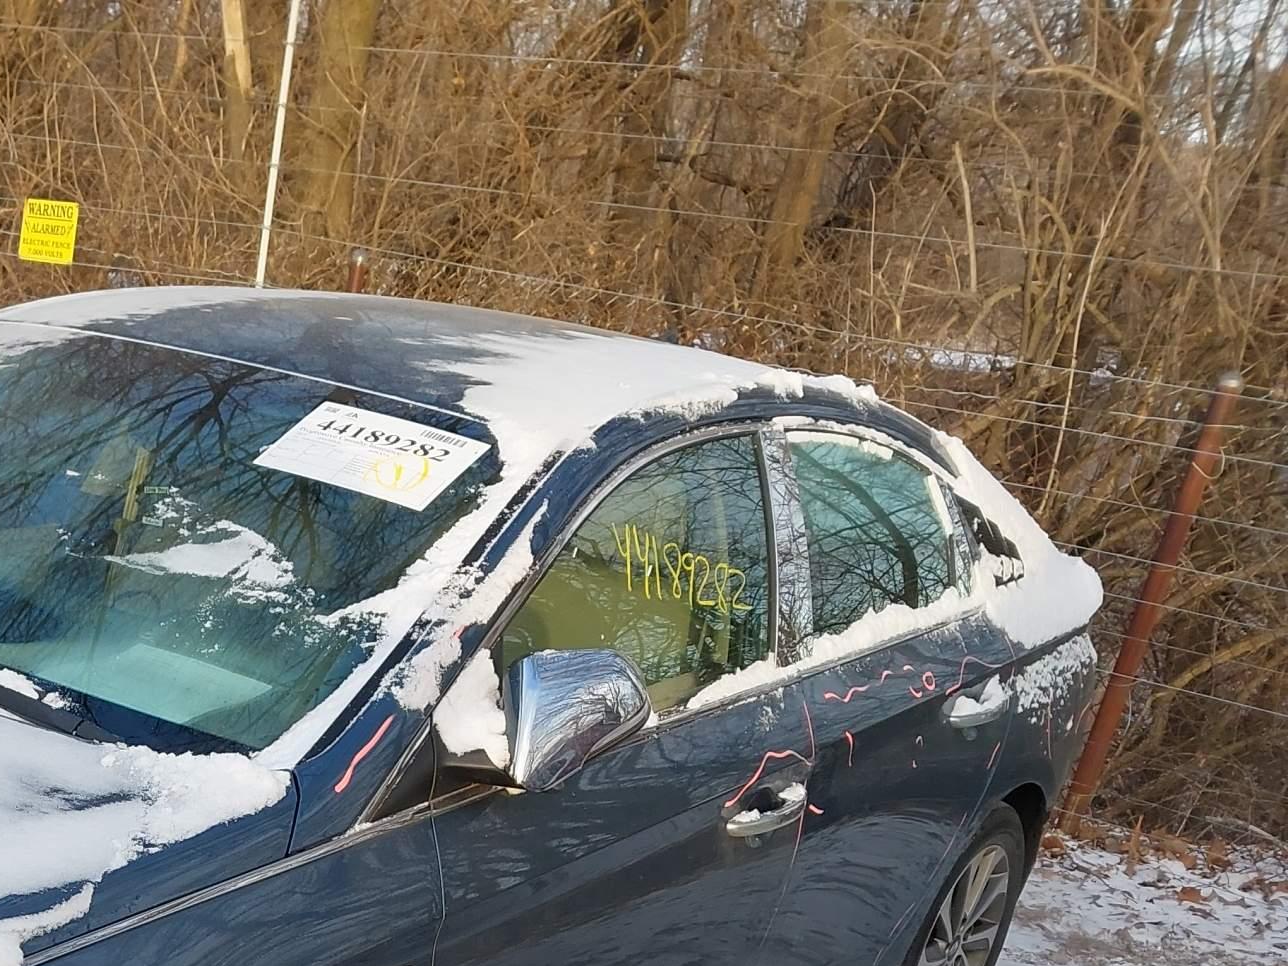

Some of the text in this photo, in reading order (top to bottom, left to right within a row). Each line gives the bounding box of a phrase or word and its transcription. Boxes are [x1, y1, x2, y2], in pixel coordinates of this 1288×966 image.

[28, 202, 73, 219] WARNING
[31, 223, 66, 236] ALARMED
[317, 419, 450, 462] 44189282
[612, 522, 753, 614] 44189282
